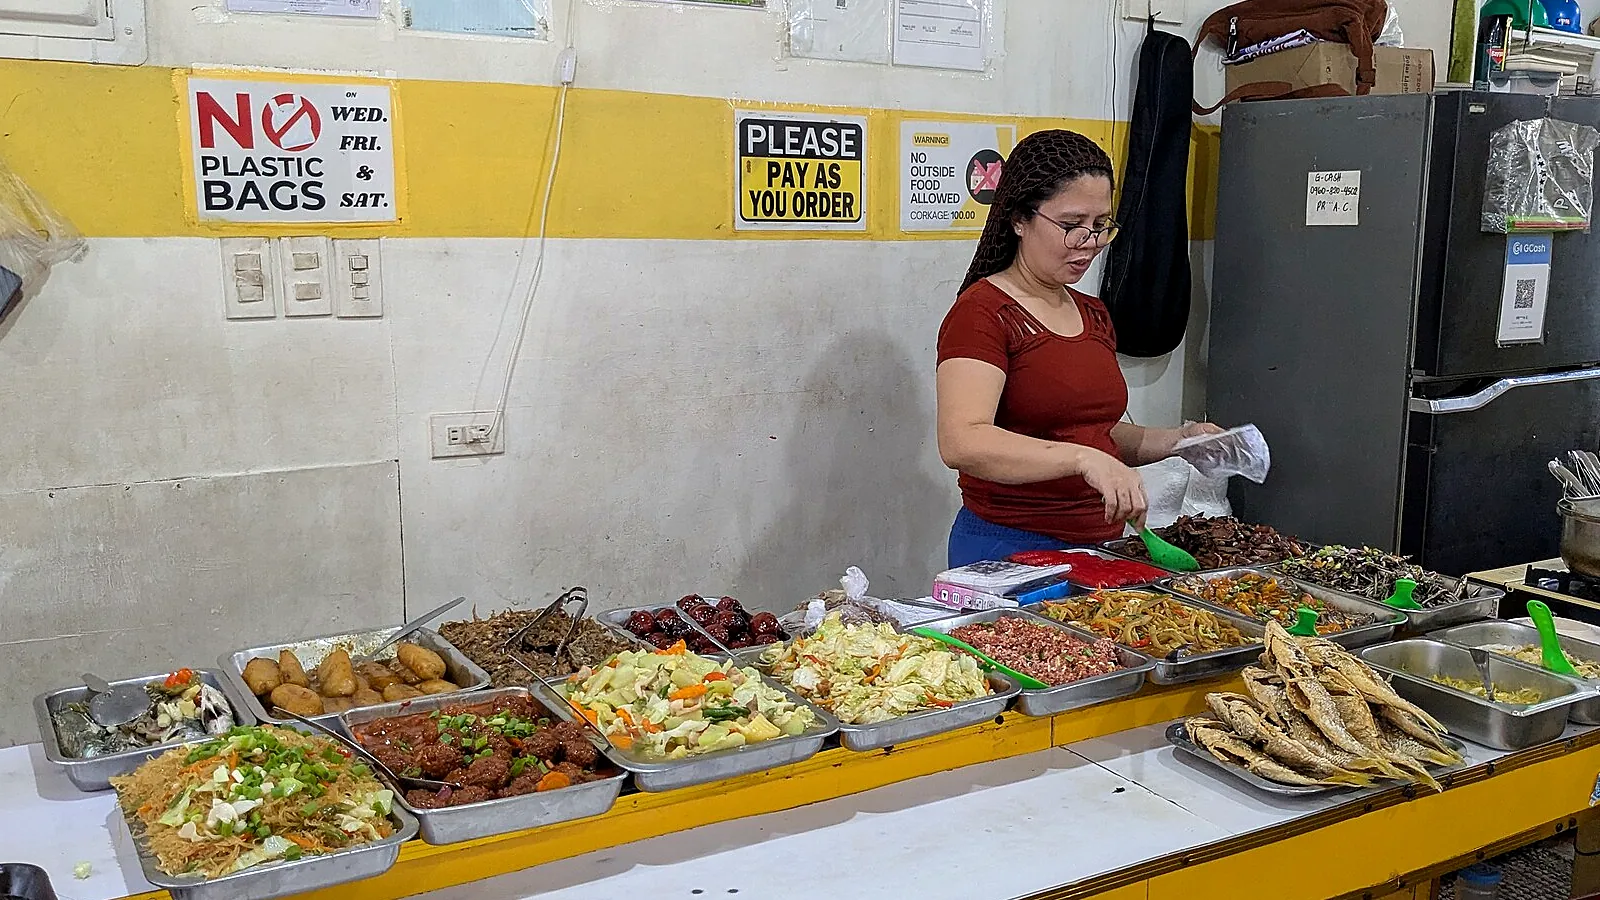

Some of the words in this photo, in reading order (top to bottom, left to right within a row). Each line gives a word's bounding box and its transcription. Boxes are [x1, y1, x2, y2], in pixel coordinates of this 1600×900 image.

[196, 91, 322, 152] NO
[331, 106, 388, 122] WED.
[339, 135, 382, 151] FRI.
[747, 124, 856, 157] PLEASE
[910, 152, 927, 163] NO
[201, 155, 324, 178] PLASTIC
[356, 165, 374, 181] &
[910, 165, 955, 177] OUTSIDE
[767, 161, 812, 189] PAY
[813, 162, 841, 189] AS
[910, 179, 940, 191] FOOD
[203, 180, 326, 211] BAGS
[339, 192, 389, 208] SAT.
[910, 193, 960, 204] ALLOWED
[749, 190, 787, 217] YOU
[795, 191, 854, 218] ORDER
